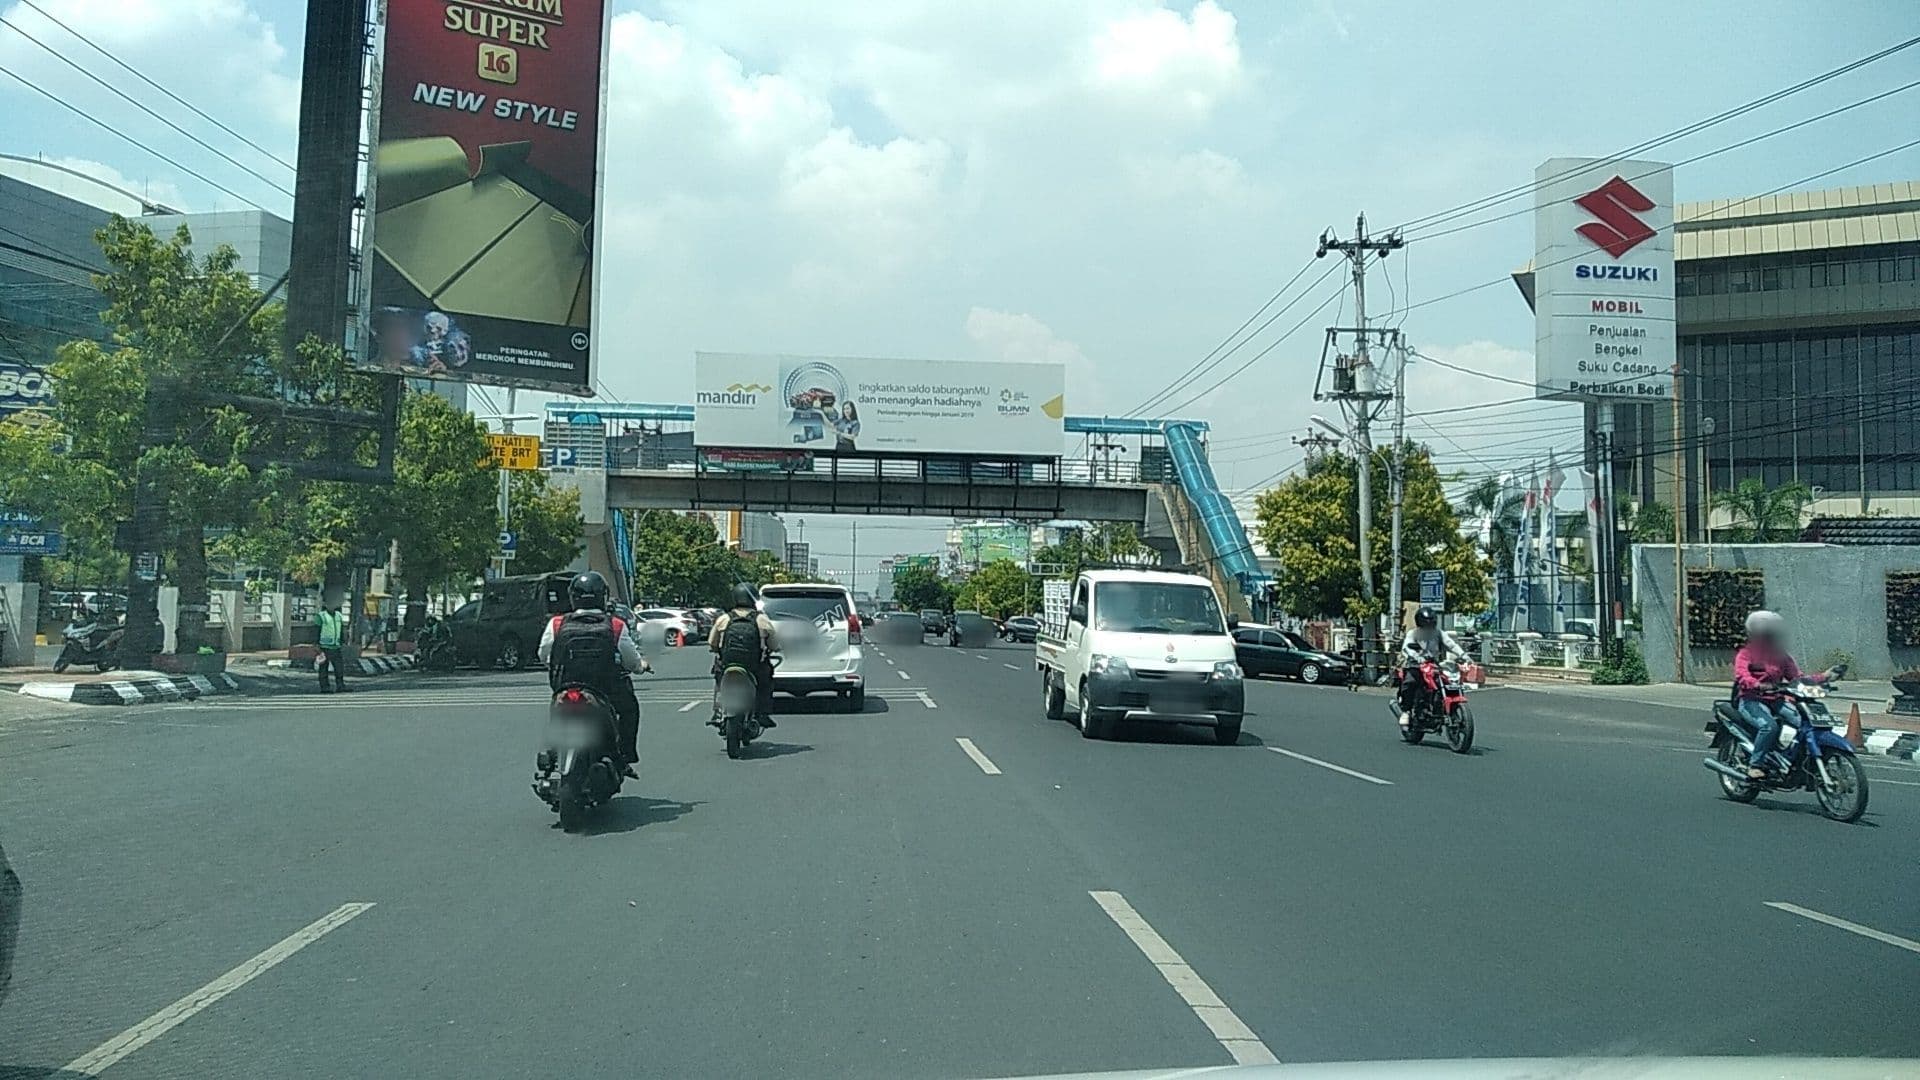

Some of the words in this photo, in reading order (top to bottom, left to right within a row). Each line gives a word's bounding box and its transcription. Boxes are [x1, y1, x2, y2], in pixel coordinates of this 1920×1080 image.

[444, 5, 549, 48] SUPER
[484, 51, 511, 73] 16
[413, 83, 486, 112] NEW
[494, 99, 578, 130] STYLE
[1576, 265, 1658, 281] SUZUKI
[1592, 300, 1644, 314] MOBIL
[1589, 325, 1646, 339] Penjualan
[500, 347, 551, 358] PERINGATAN:
[1595, 343, 1642, 357] Bengkel
[476, 353, 516, 363] MEROKOK
[1578, 361, 1608, 373] Suku
[1613, 362, 1657, 376] Cadang
[859, 384, 906, 394] tingkatkan
[907, 384, 931, 394] saldo
[932, 386, 990, 396] tabunganMU
[1570, 381, 1634, 396] Perbaikan
[1638, 383, 1665, 396] Bodi
[697, 390, 756, 405] mandiri
[859, 395, 877, 404] dan
[878, 396, 933, 407] menangkan
[934, 397, 981, 408] hadiahnya
[502, 436, 522, 447] HATI
[512, 448, 532, 458] BRT
[556, 448, 572, 465] P
[20, 535, 45, 546] BCA
